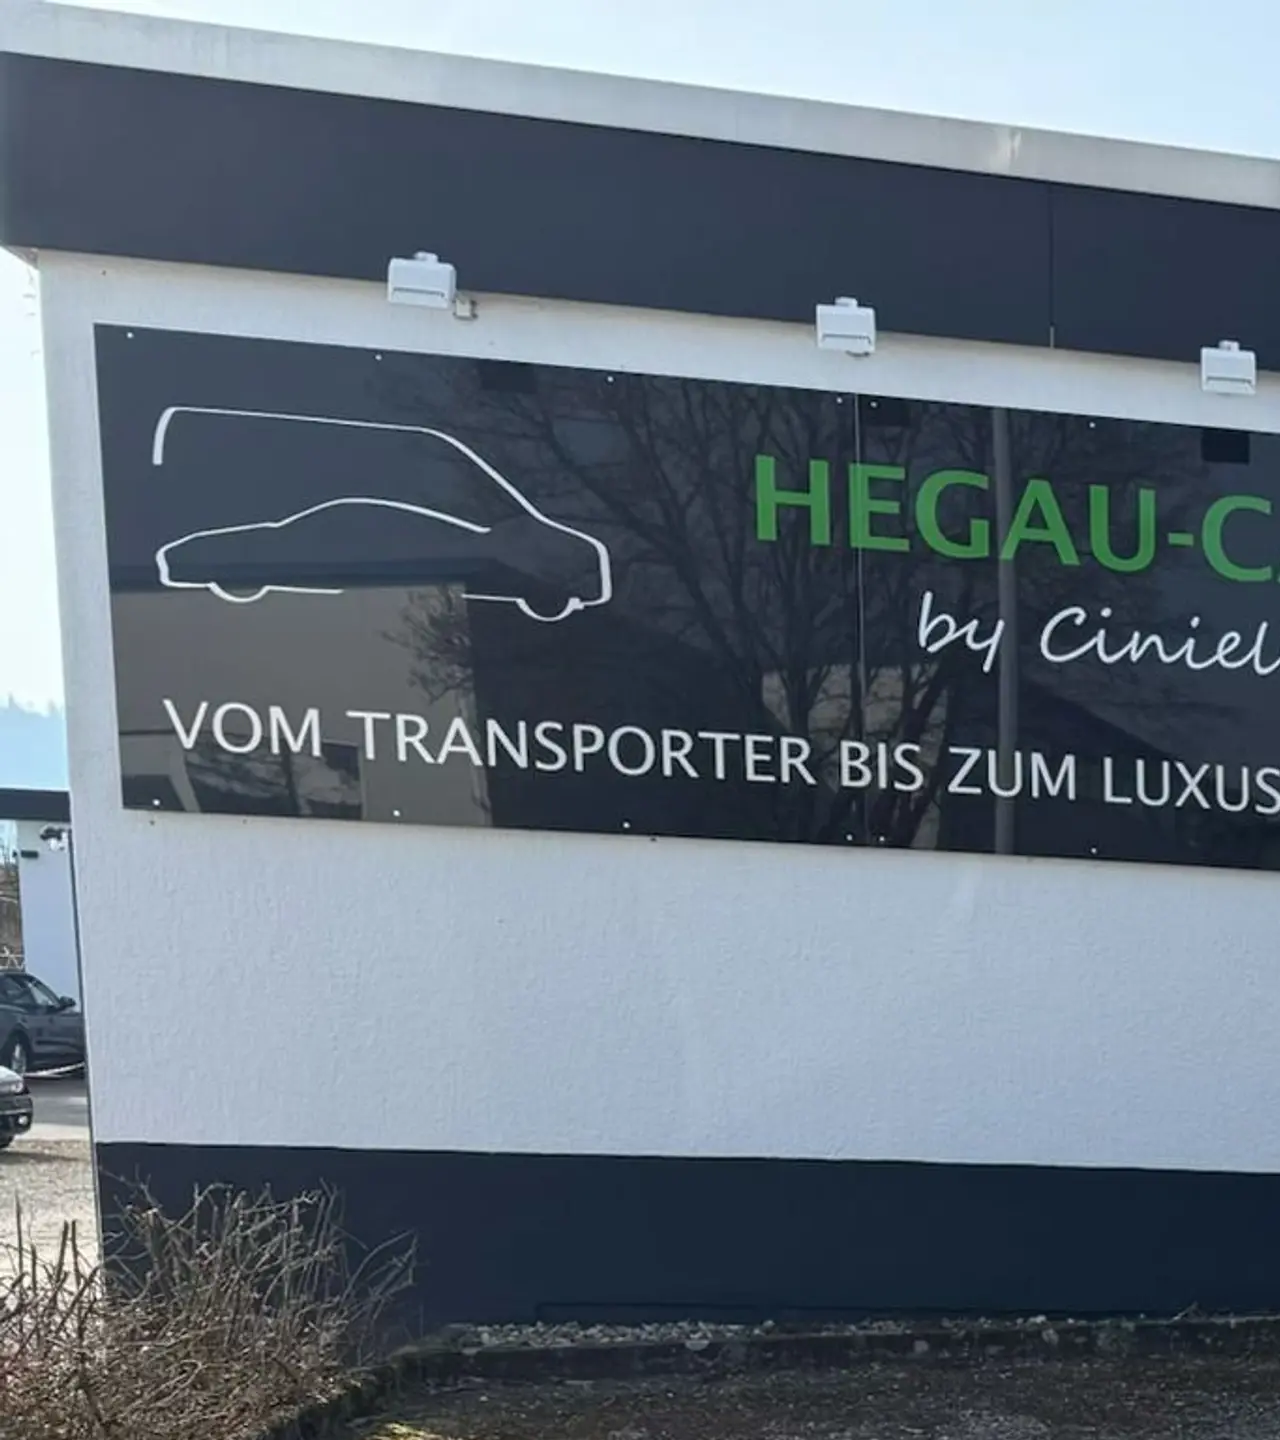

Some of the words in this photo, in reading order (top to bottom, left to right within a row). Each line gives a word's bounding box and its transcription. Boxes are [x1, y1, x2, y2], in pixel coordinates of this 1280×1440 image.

[918, 591, 1004, 672] by
[163, 699, 322, 757] VOM
[346, 710, 816, 786] TRANSPORTER
[840, 741, 924, 790] BIS
[947, 747, 1077, 800] ZUM
